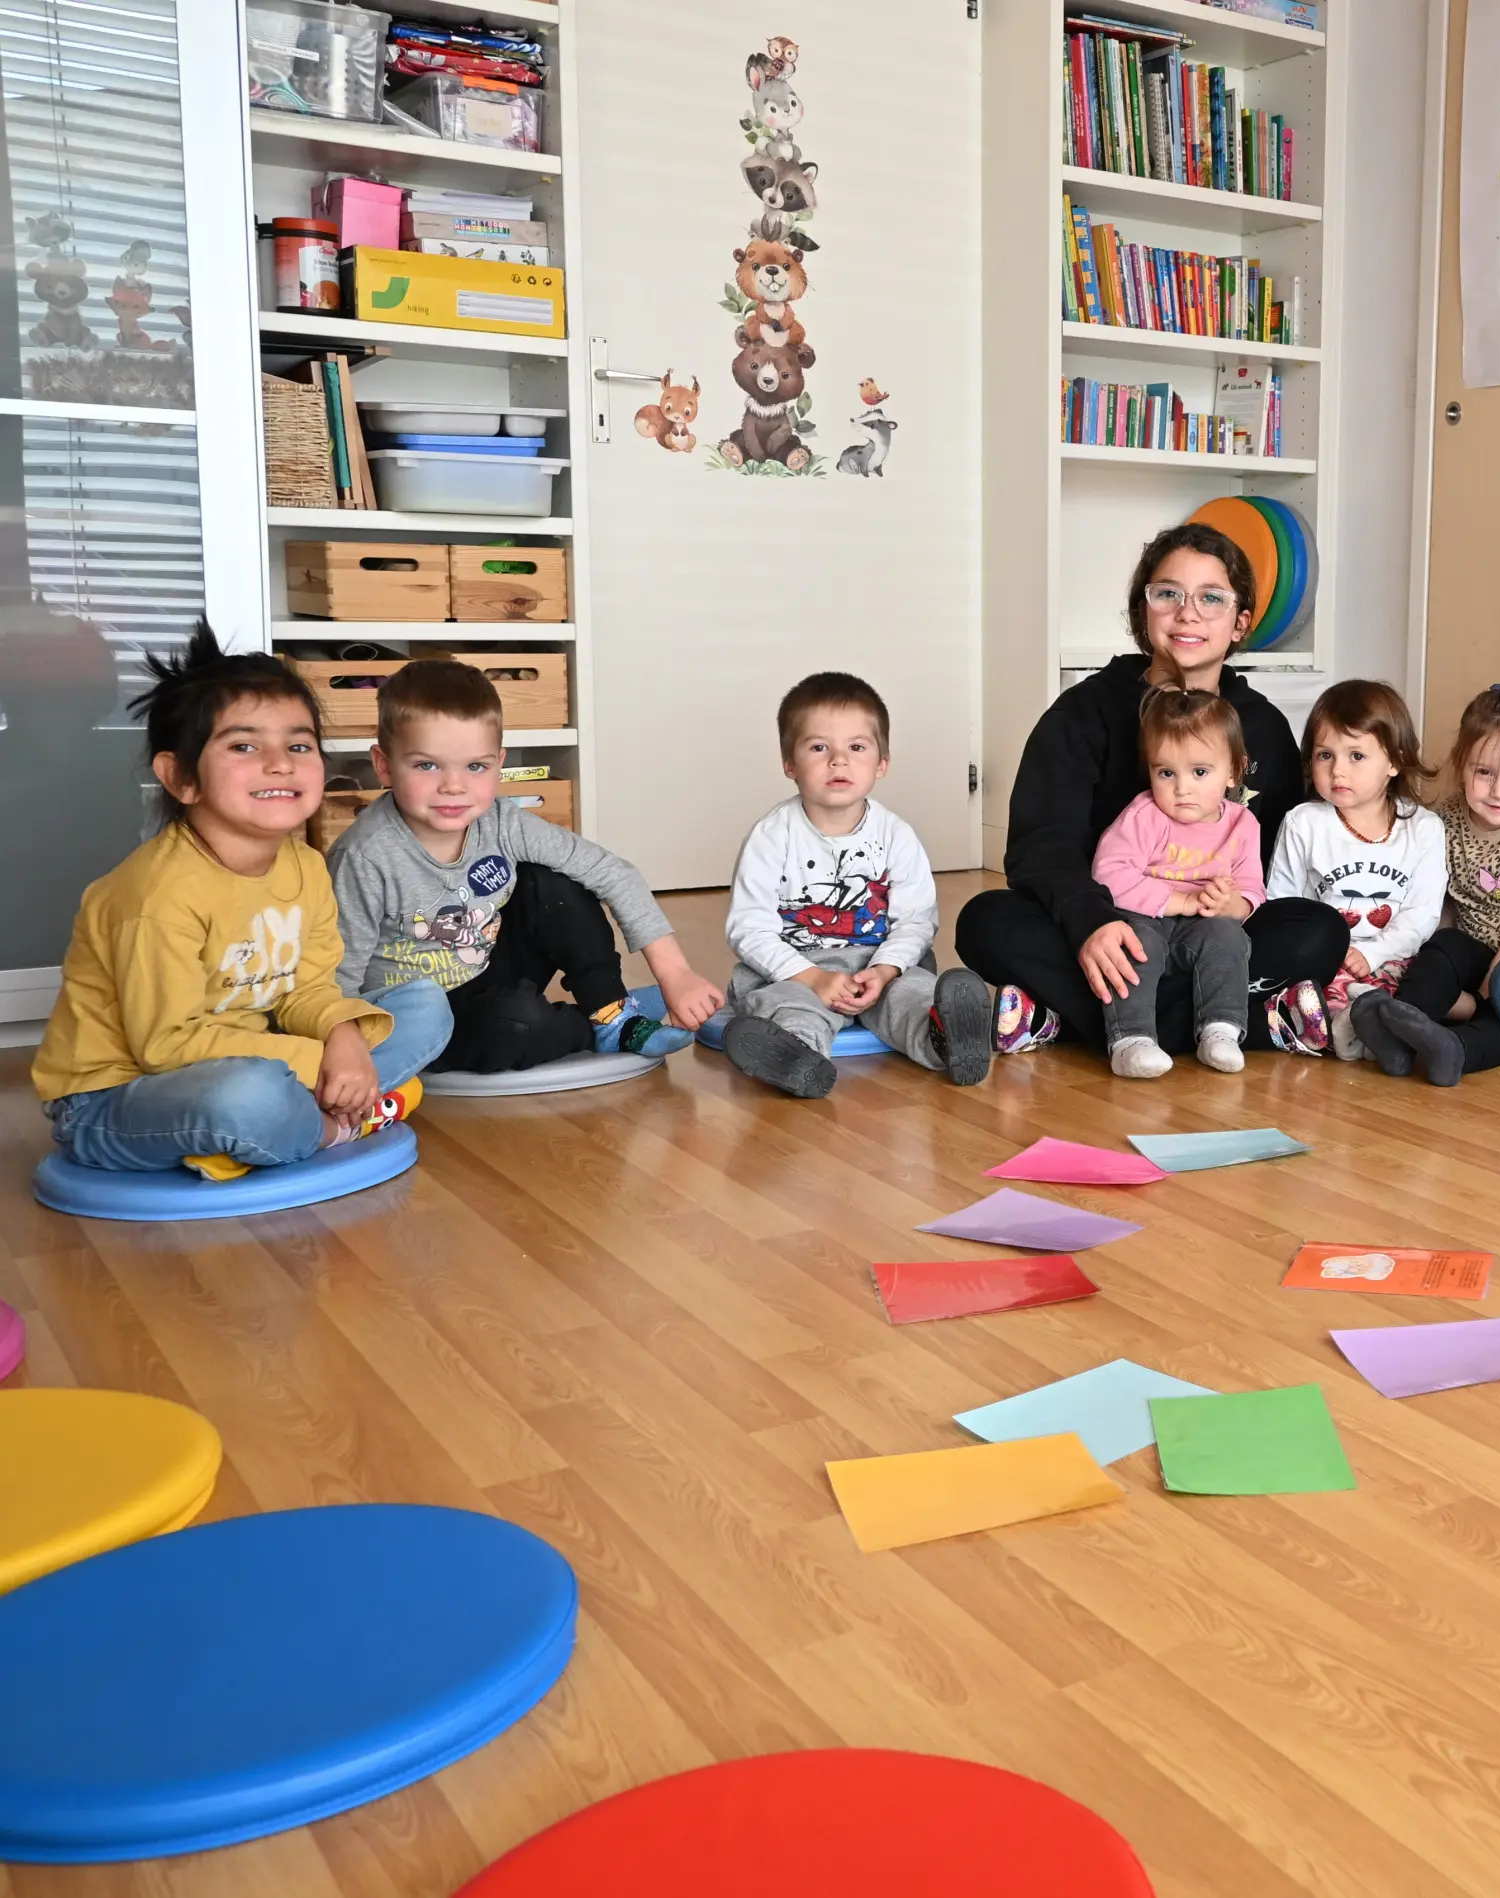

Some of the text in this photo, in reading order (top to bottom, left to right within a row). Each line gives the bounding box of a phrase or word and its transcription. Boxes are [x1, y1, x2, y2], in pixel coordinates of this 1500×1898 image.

[470, 858, 499, 884] PARTY
[1323, 861, 1409, 888] SELF LOVE
